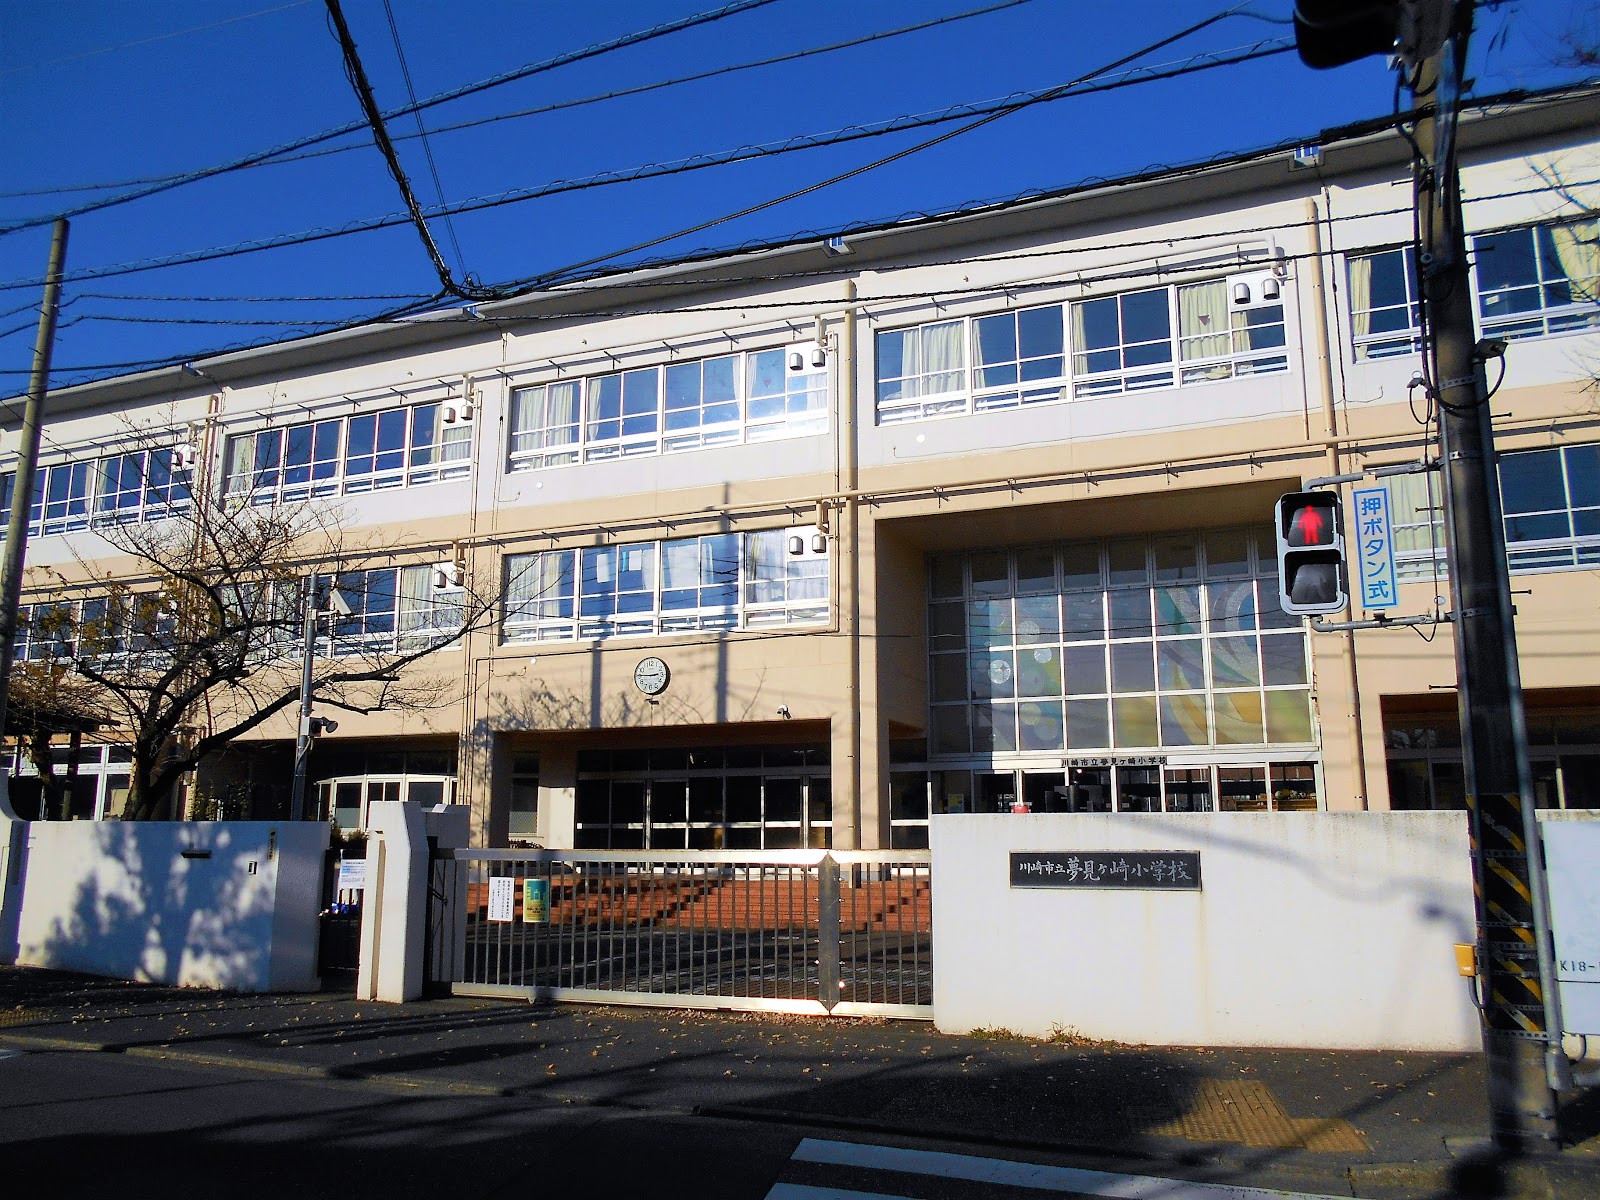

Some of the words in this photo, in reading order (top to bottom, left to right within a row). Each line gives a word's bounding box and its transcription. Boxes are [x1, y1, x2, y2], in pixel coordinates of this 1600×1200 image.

[1361, 497, 1389, 599] 押ボタン式
[1559, 960, 1600, 972] K18-
